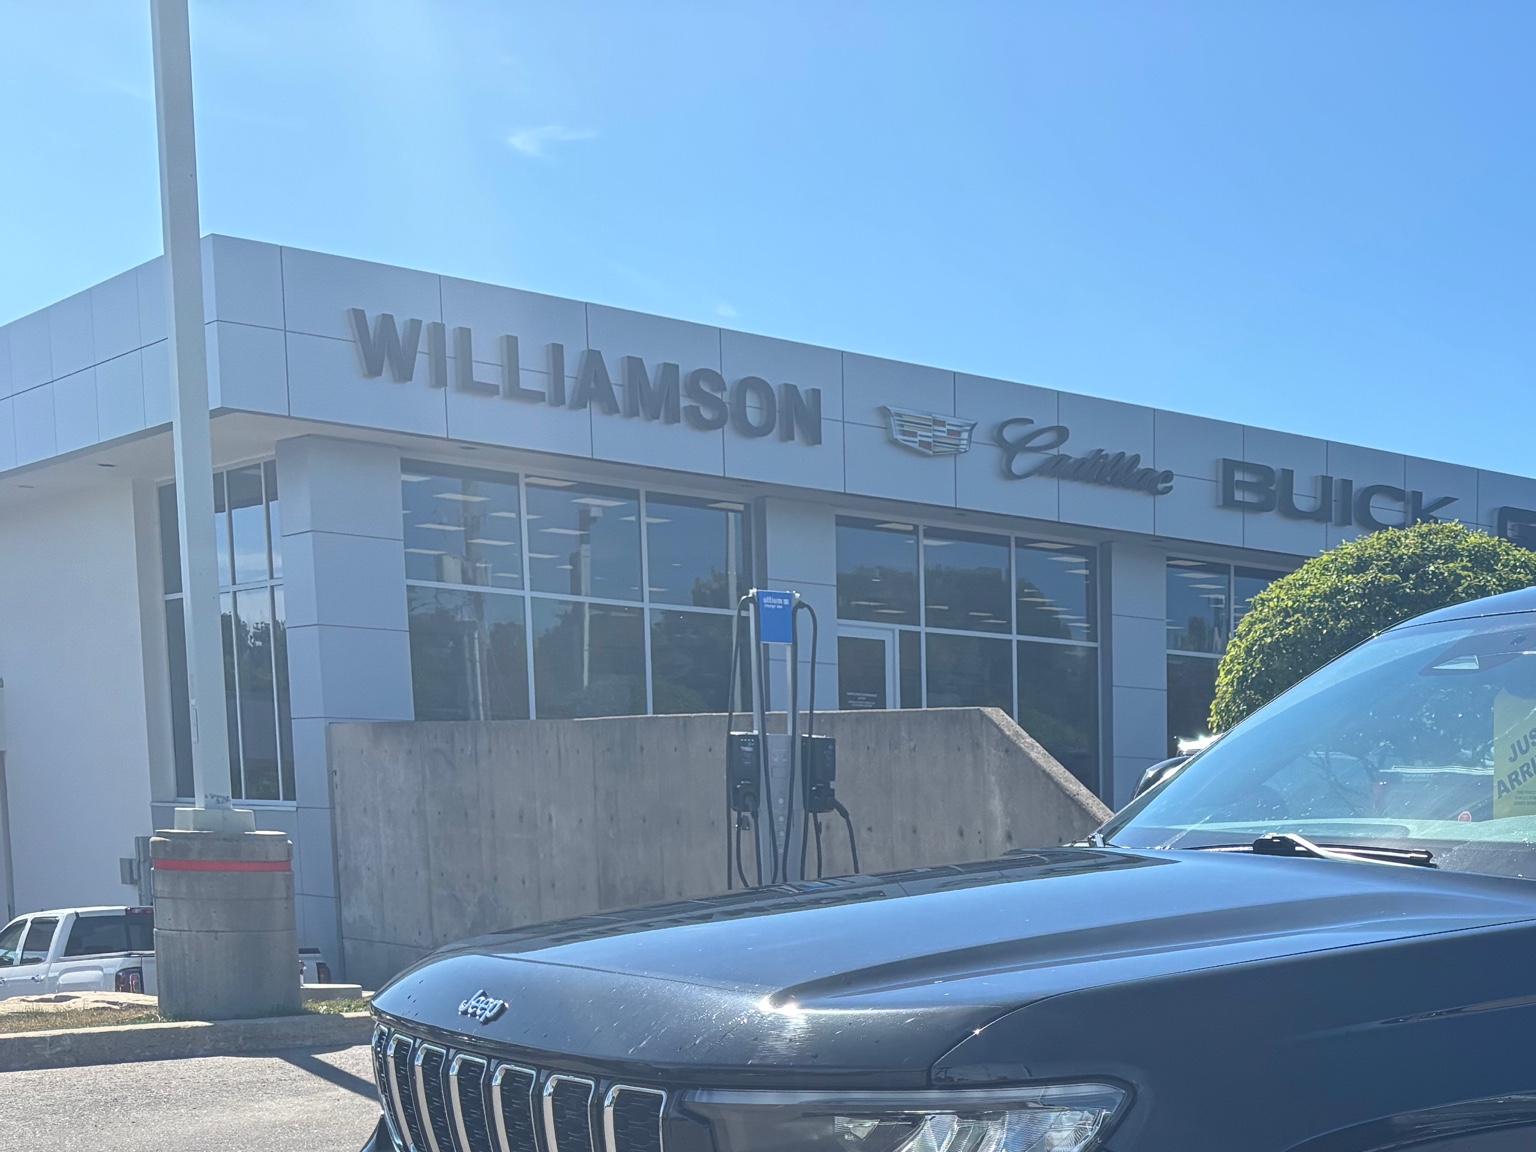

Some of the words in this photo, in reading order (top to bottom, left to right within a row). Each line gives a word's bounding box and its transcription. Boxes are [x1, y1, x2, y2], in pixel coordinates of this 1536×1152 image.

[346, 307, 822, 446] WILLIAMSON
[993, 417, 1174, 496] Cadillac
[1217, 458, 1459, 531] BUICK
[458, 989, 504, 1022] Jeep
